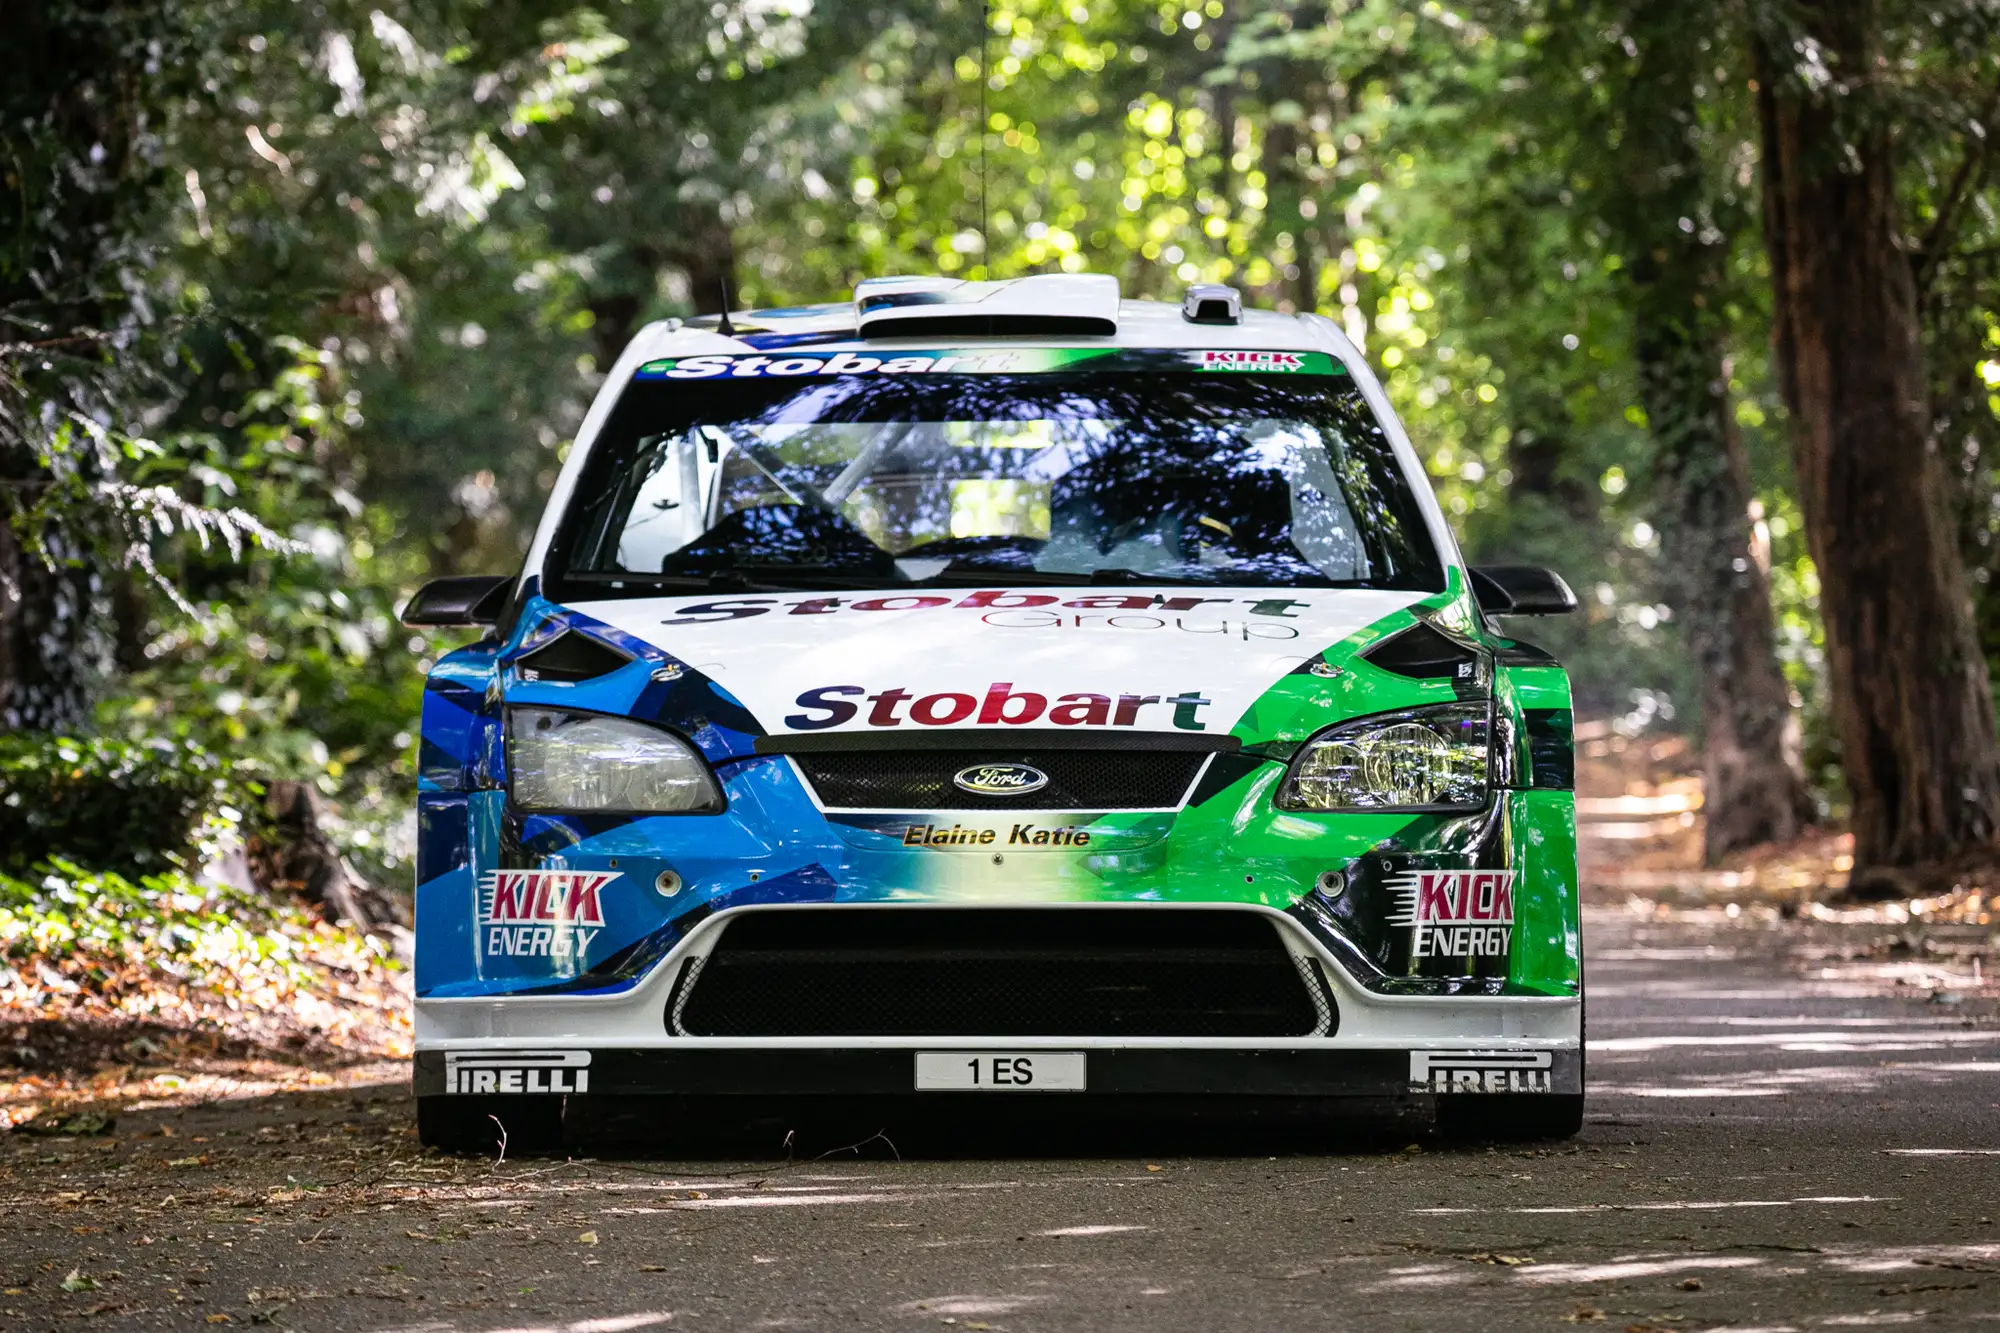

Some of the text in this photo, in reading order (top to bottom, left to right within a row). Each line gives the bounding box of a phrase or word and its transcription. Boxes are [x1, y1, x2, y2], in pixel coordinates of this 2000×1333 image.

[666, 352, 1019, 378] Stobart
[1203, 363, 1305, 372] ENERGY
[1205, 352, 1299, 363] KICK
[660, 591, 1311, 625] Stobart
[981, 610, 1300, 641] Group
[784, 682, 1211, 730] Stobart
[974, 767, 1027, 786] Ford
[902, 824, 1090, 846] Elaine Katie
[490, 873, 610, 923] KICK
[1416, 873, 1515, 922] KICK
[487, 927, 599, 957] ENERGY
[1412, 927, 1513, 957] ENERGY
[445, 1050, 592, 1094] PIRELLI
[967, 1058, 1033, 1085] 1 ES
[1409, 1050, 1553, 1094] PIRELLI
